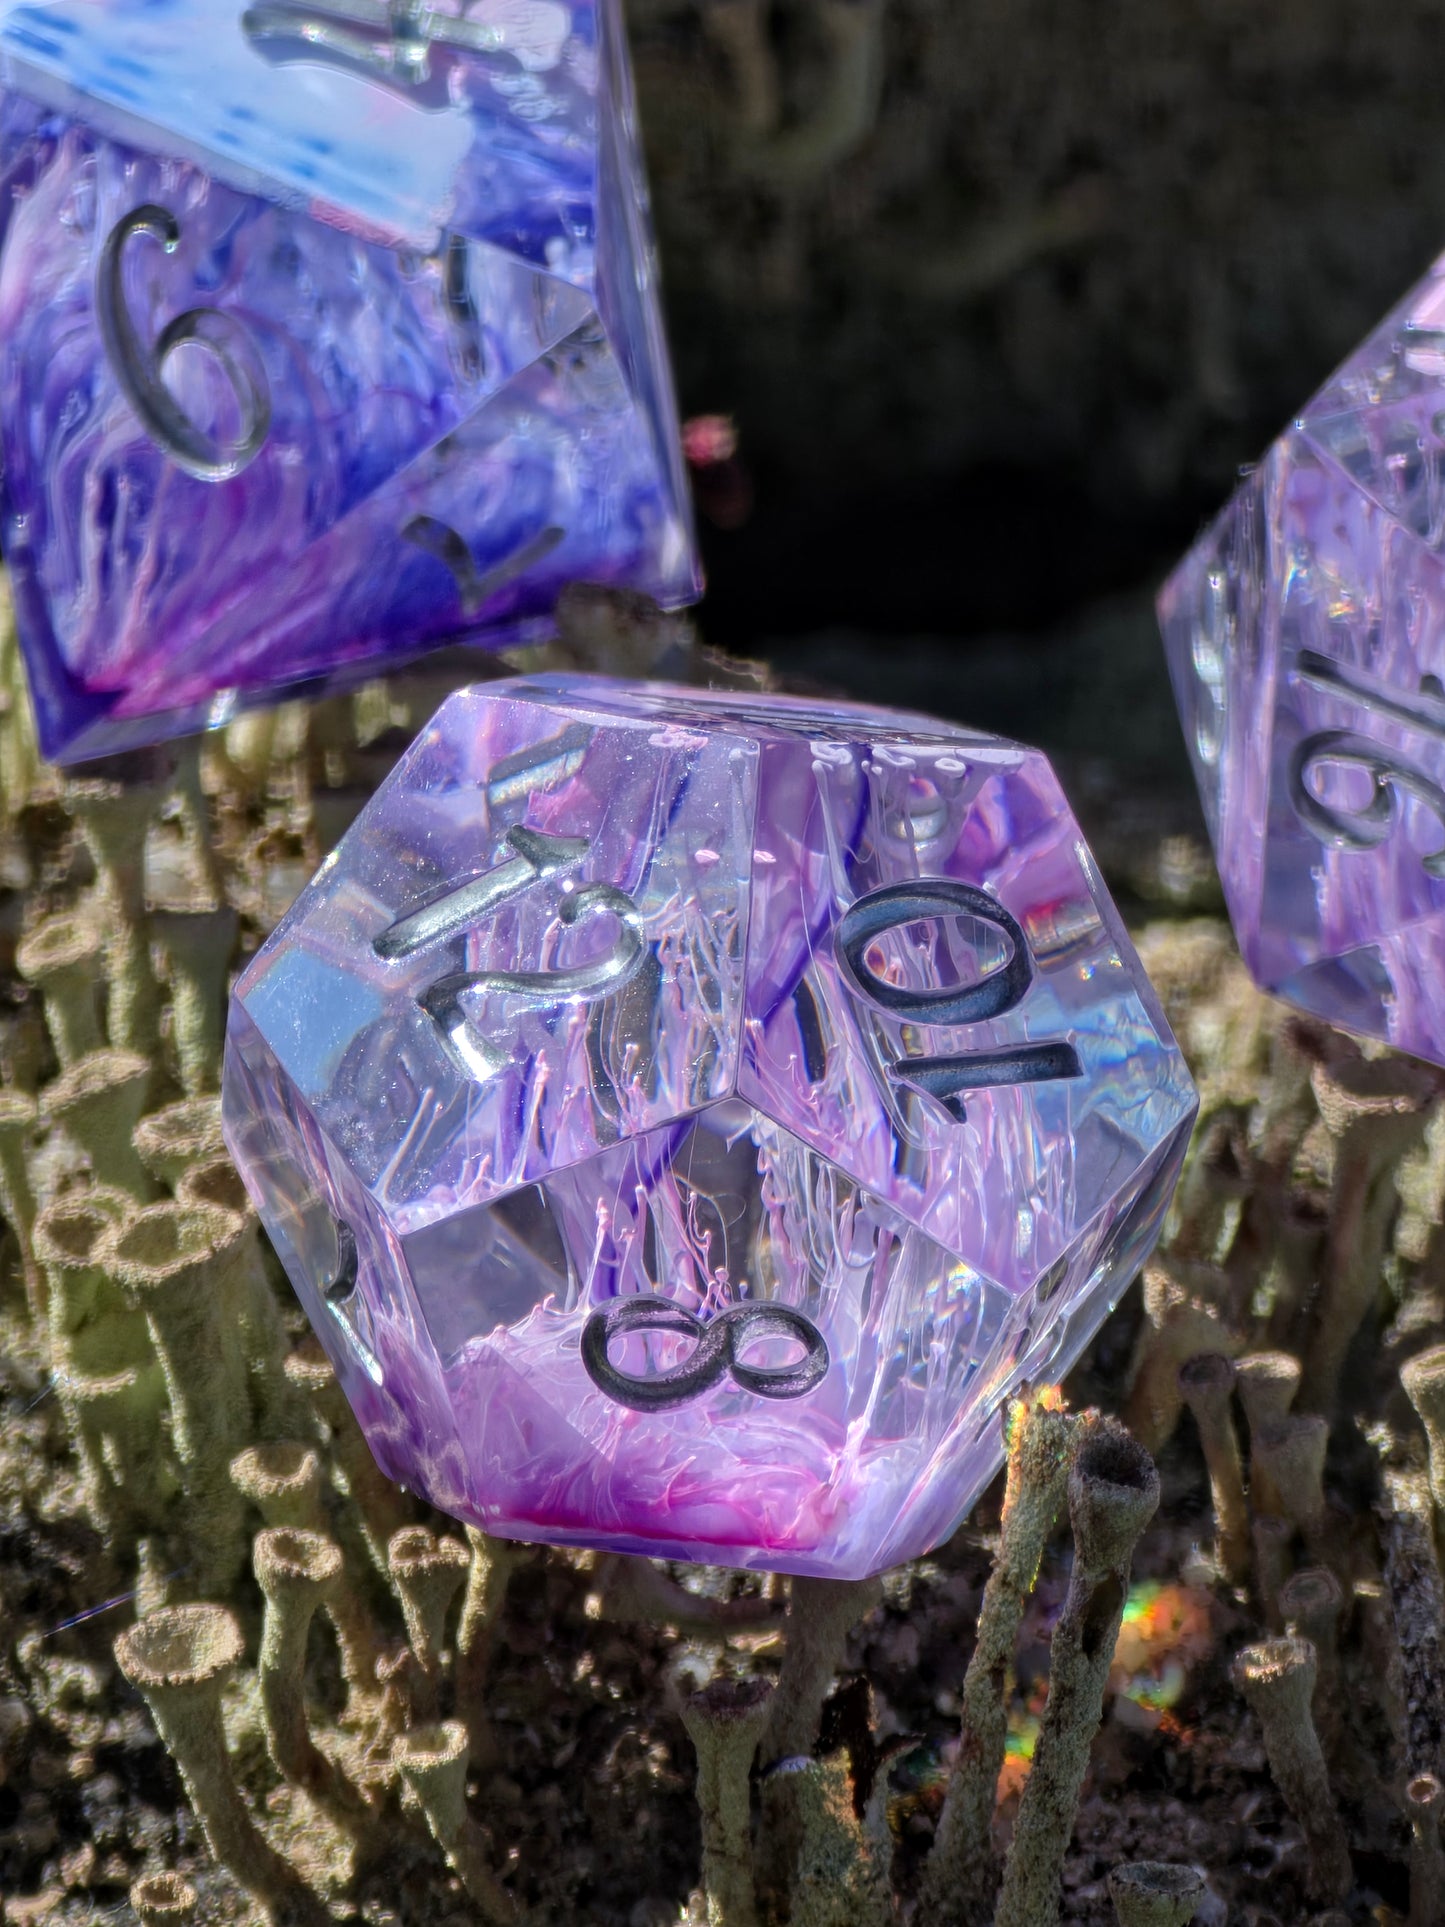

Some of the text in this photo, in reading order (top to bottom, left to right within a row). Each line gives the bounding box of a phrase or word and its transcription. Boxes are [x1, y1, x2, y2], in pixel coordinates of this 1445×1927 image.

[96, 204, 271, 482] 6
[372, 823, 648, 1082] 12
[834, 877, 1084, 1124] 10
[580, 1295, 830, 1413] 8
